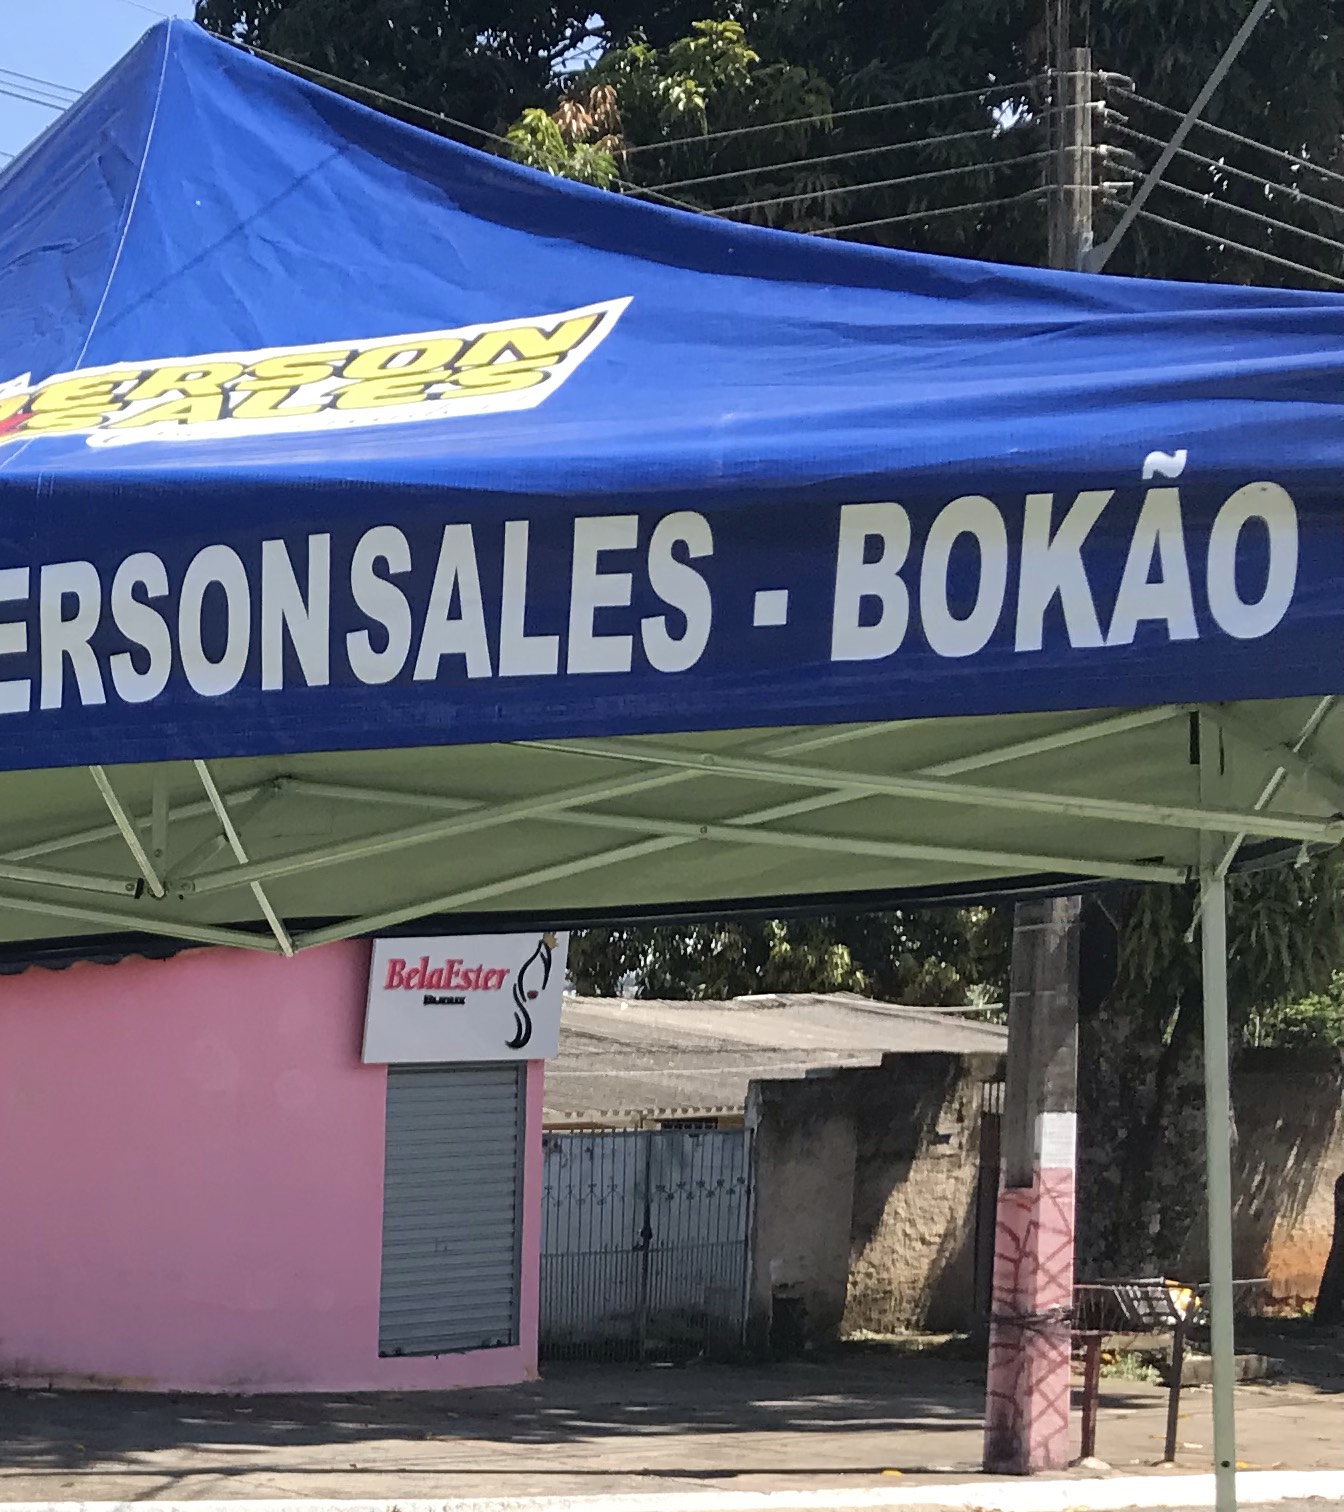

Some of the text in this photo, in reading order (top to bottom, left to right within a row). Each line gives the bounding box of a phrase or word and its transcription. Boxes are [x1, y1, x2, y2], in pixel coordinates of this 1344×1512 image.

[20, 355, 552, 434] SALES
[345, 510, 714, 685] SALES
[830, 449, 1299, 663] BOKÃO
[383, 955, 511, 991] BelaEster
